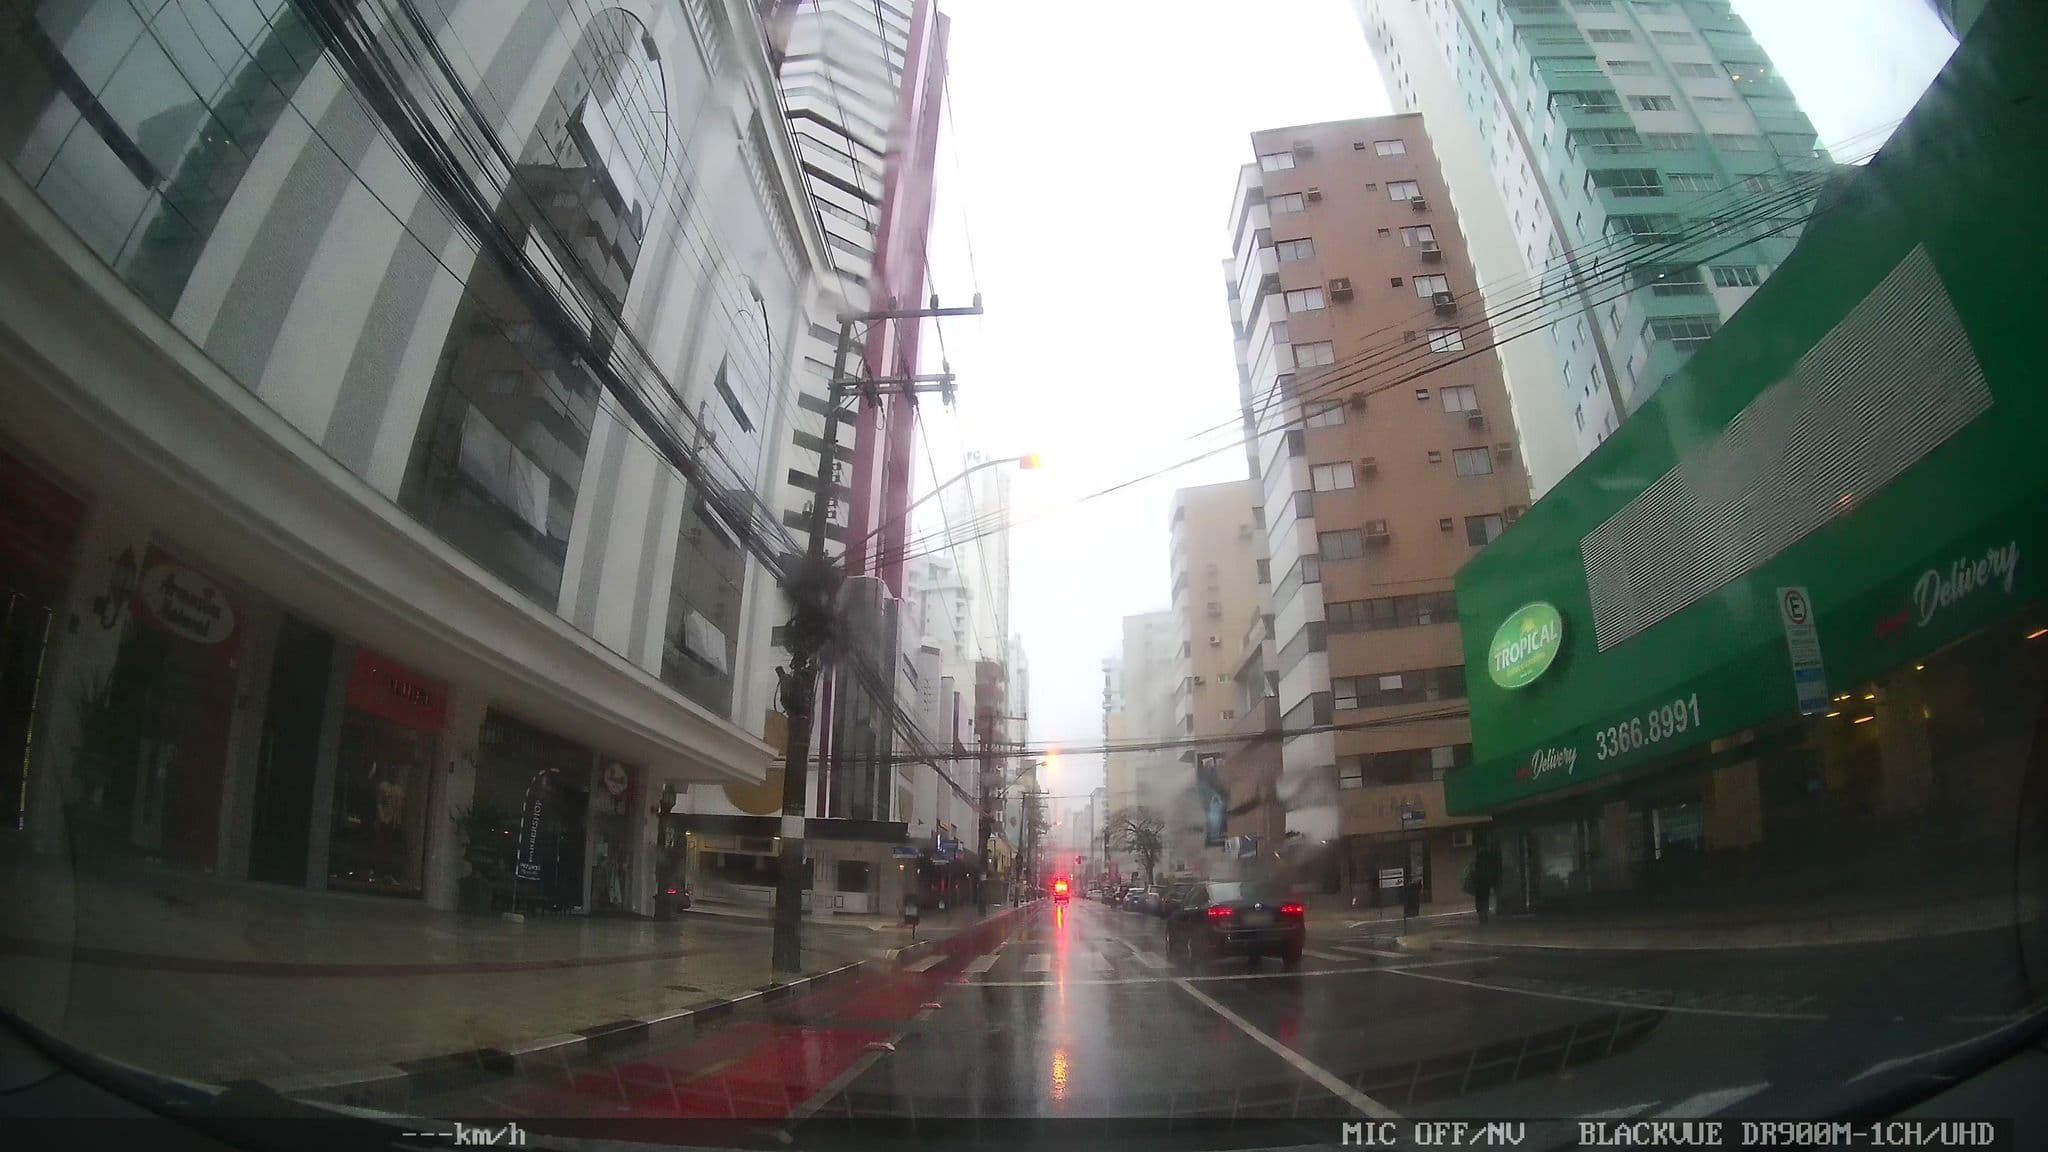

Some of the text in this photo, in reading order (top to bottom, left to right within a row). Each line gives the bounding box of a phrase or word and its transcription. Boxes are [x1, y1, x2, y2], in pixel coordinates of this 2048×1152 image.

[1790, 596, 1802, 618] E
[1913, 540, 2019, 628] Delivery
[1494, 619, 1558, 672] TROPICAL
[1531, 693, 1701, 780] Delivery 3366.8991
